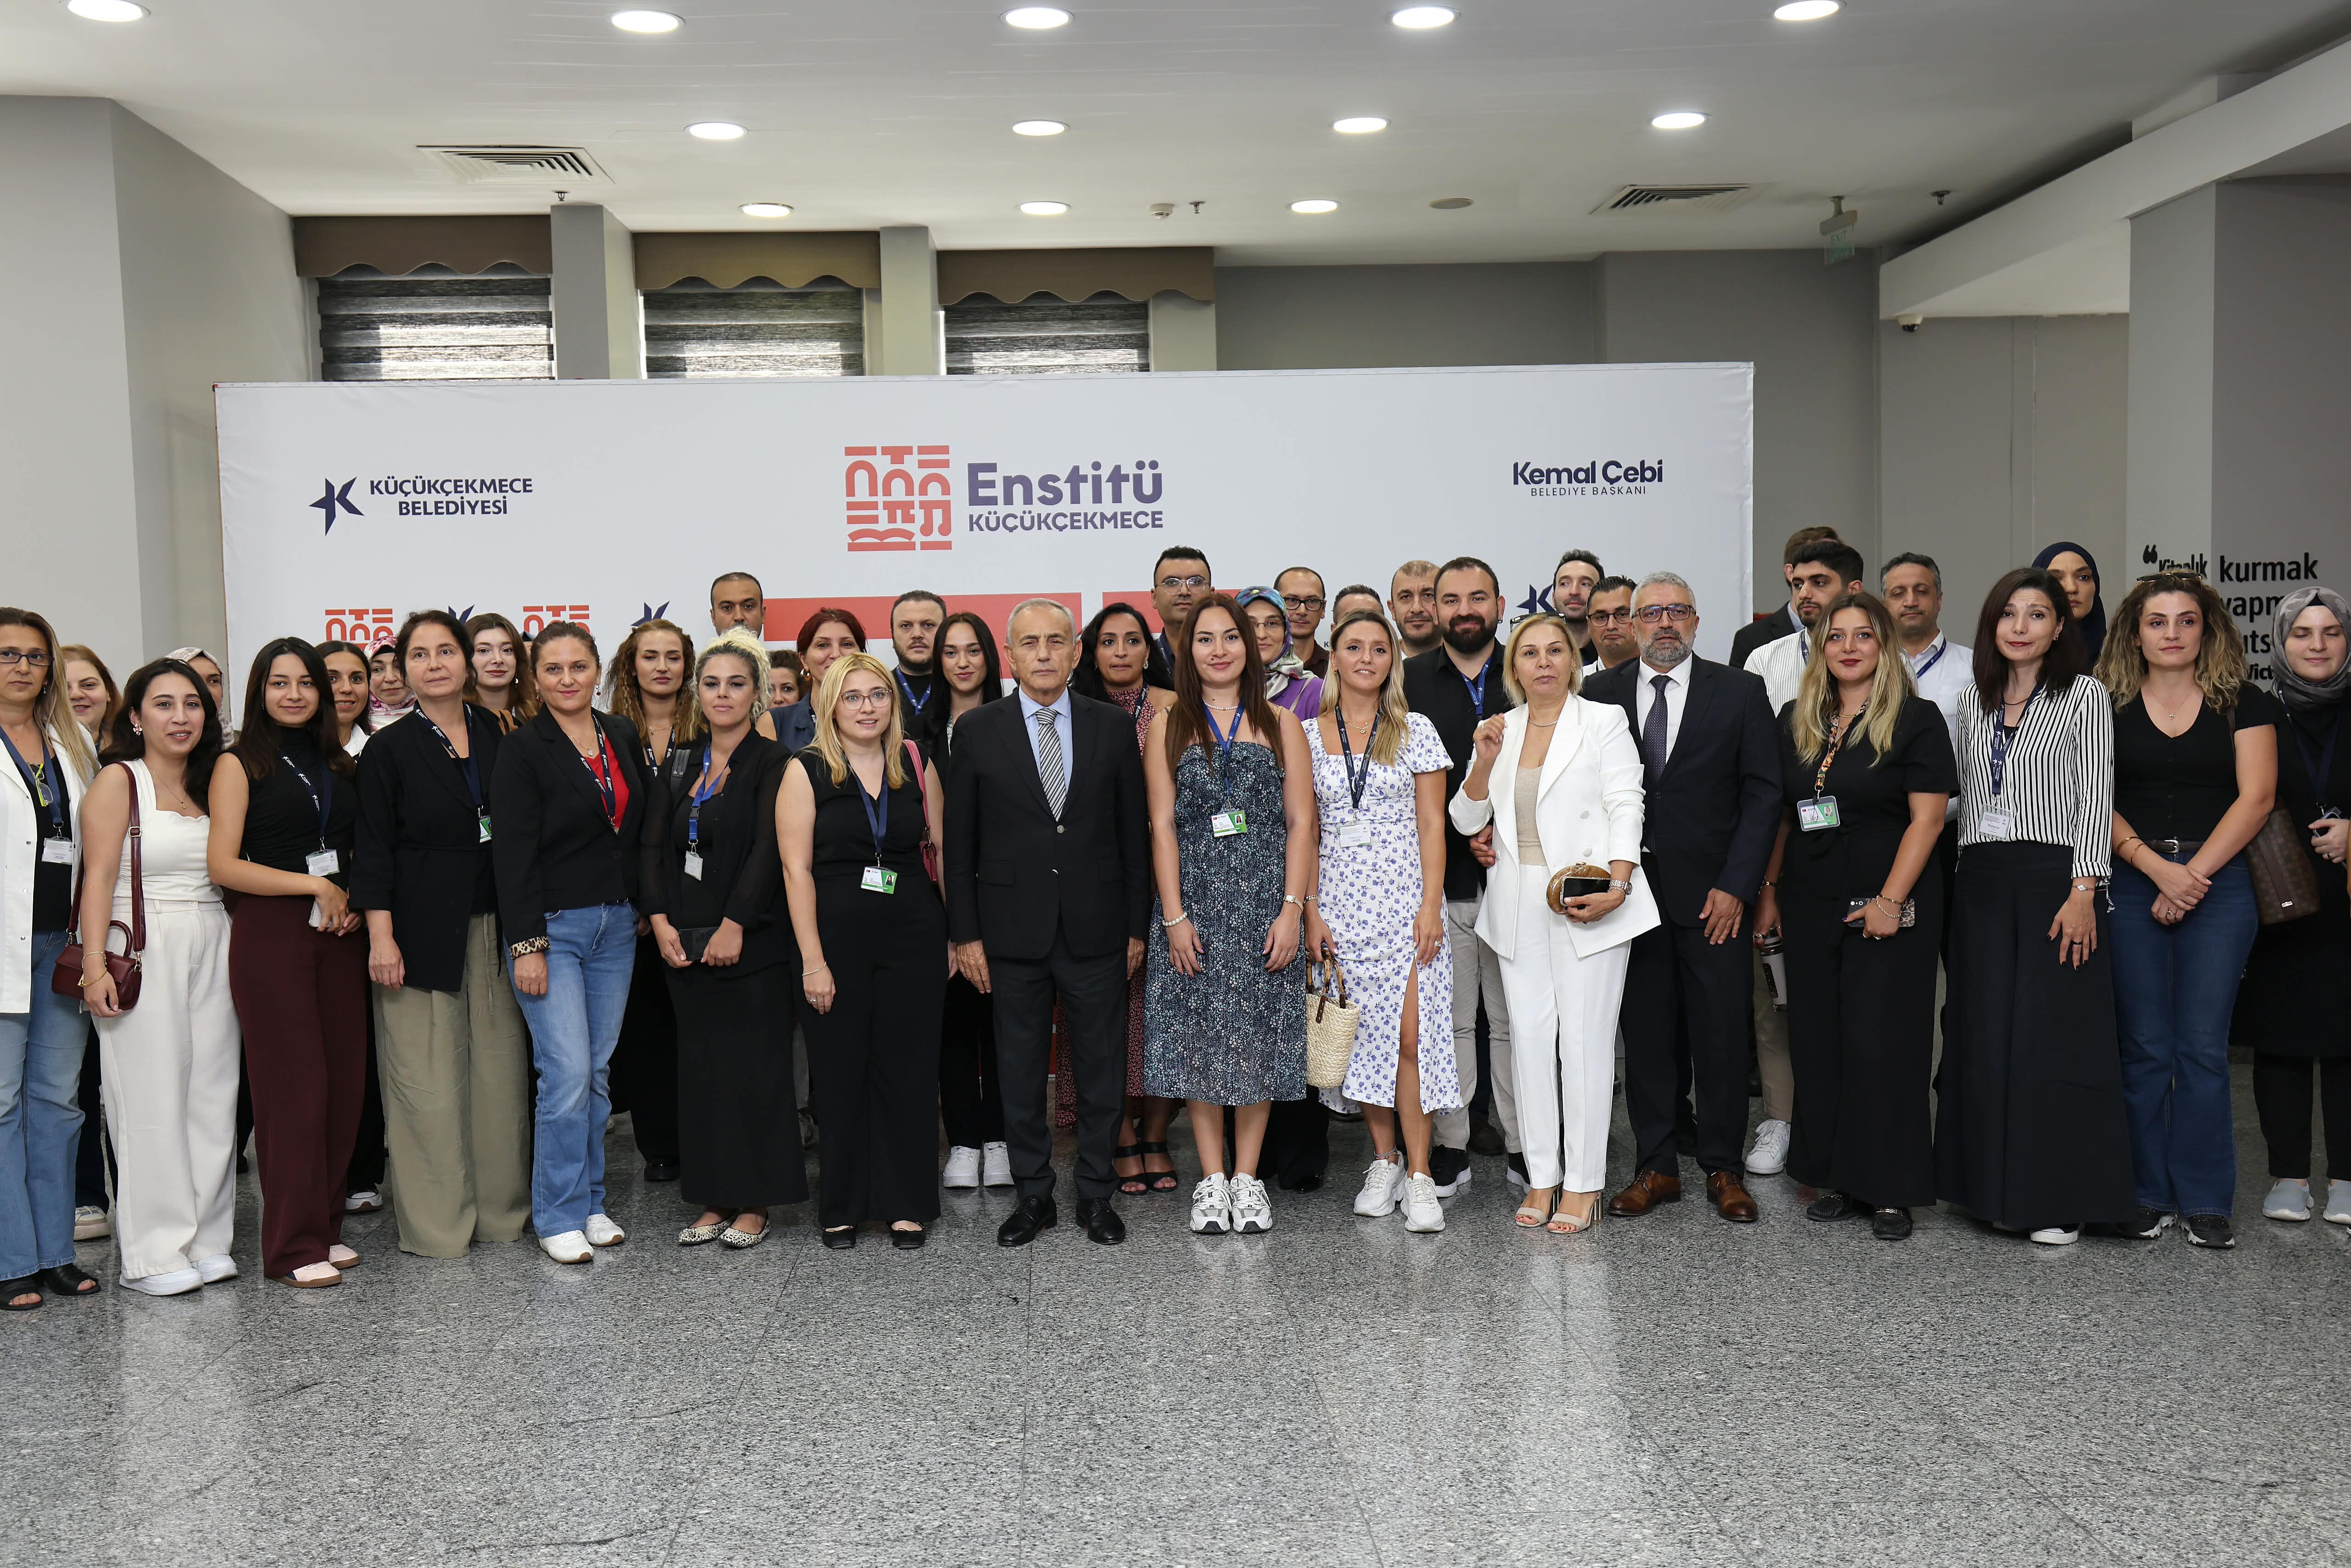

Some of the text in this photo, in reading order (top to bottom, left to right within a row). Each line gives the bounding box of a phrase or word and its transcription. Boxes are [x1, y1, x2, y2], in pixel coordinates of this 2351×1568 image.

[967, 460, 1163, 506] Enstitü
[1513, 459, 1663, 485] Kemal Çebi
[370, 476, 533, 496] KÜÇÜKÇEKMECE
[1531, 484, 1646, 496] BELEDİYE BAŞKANI
[399, 495, 507, 516] BELEDİYESİ
[968, 510, 1163, 533] KÜÇÜKÇEKMECE
[2220, 552, 2318, 583] kurmak
